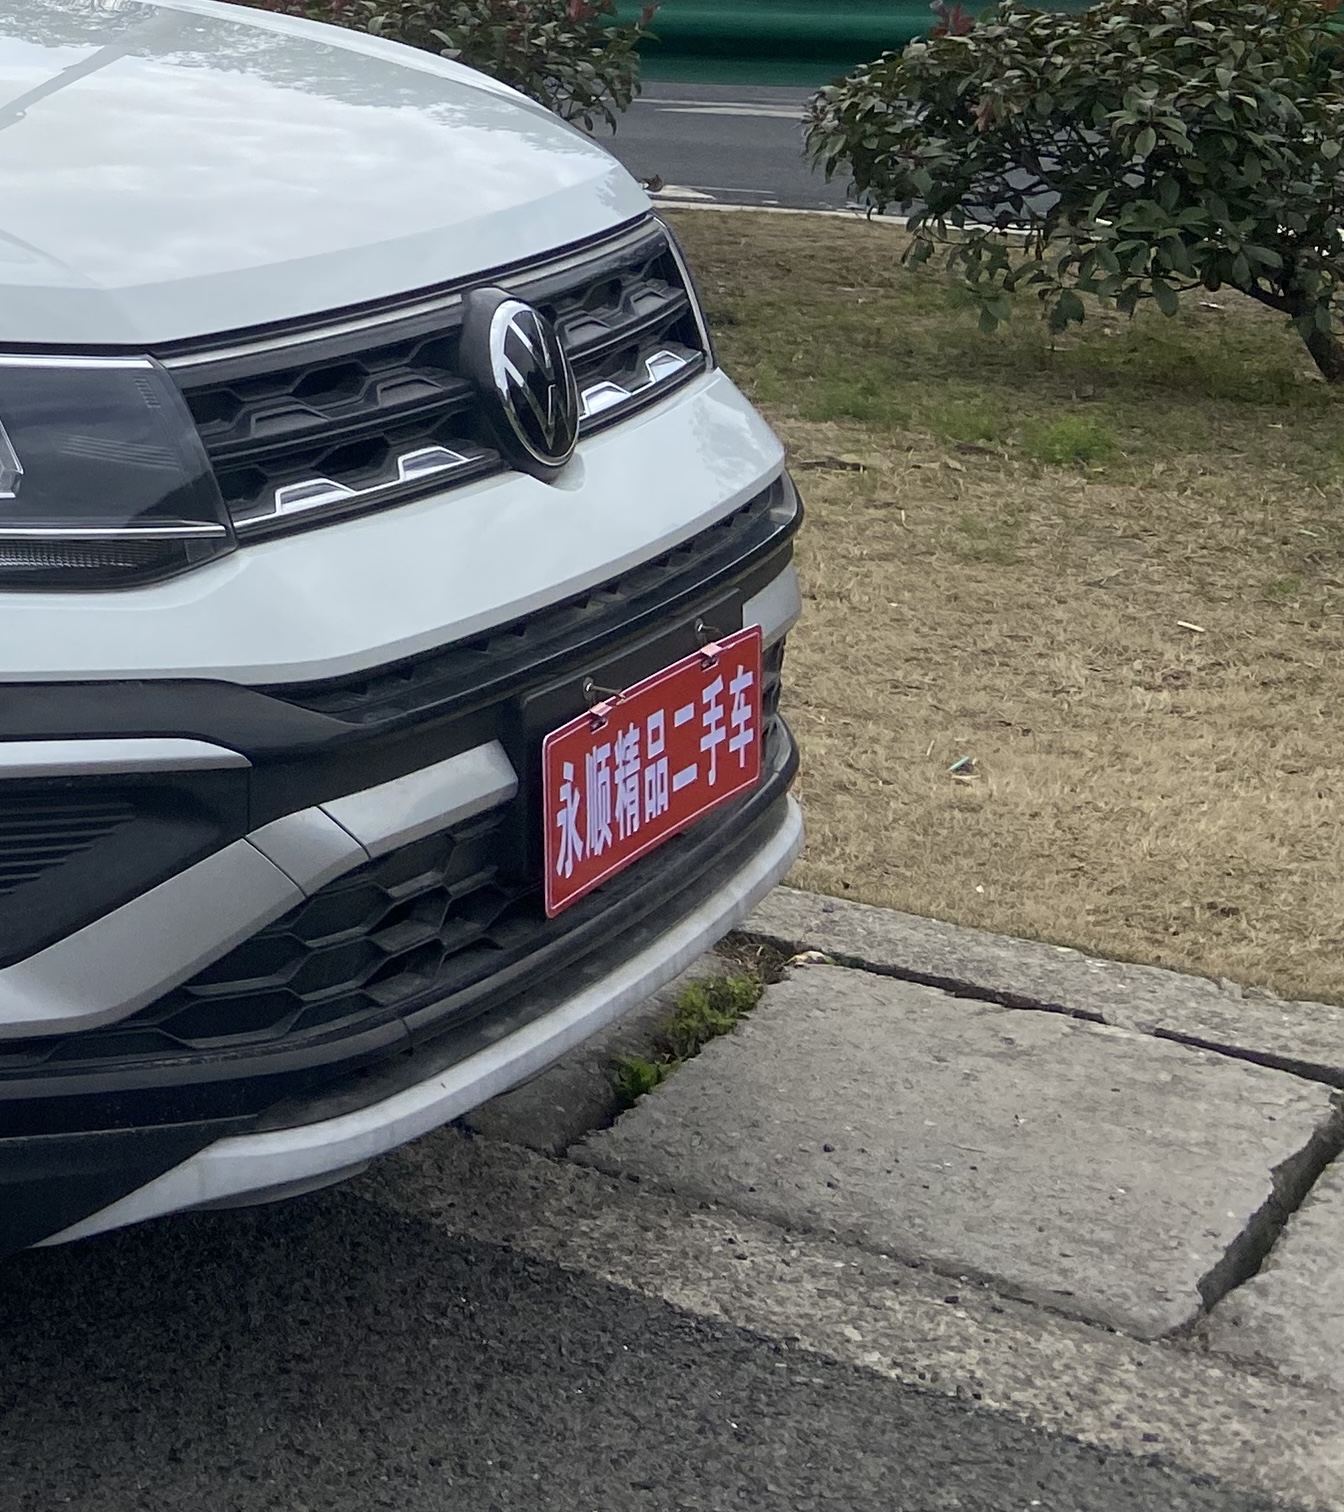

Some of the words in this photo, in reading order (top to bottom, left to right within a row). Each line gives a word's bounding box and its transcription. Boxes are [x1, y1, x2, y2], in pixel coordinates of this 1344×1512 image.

[555, 663, 755, 880] 永顺精品二手车
